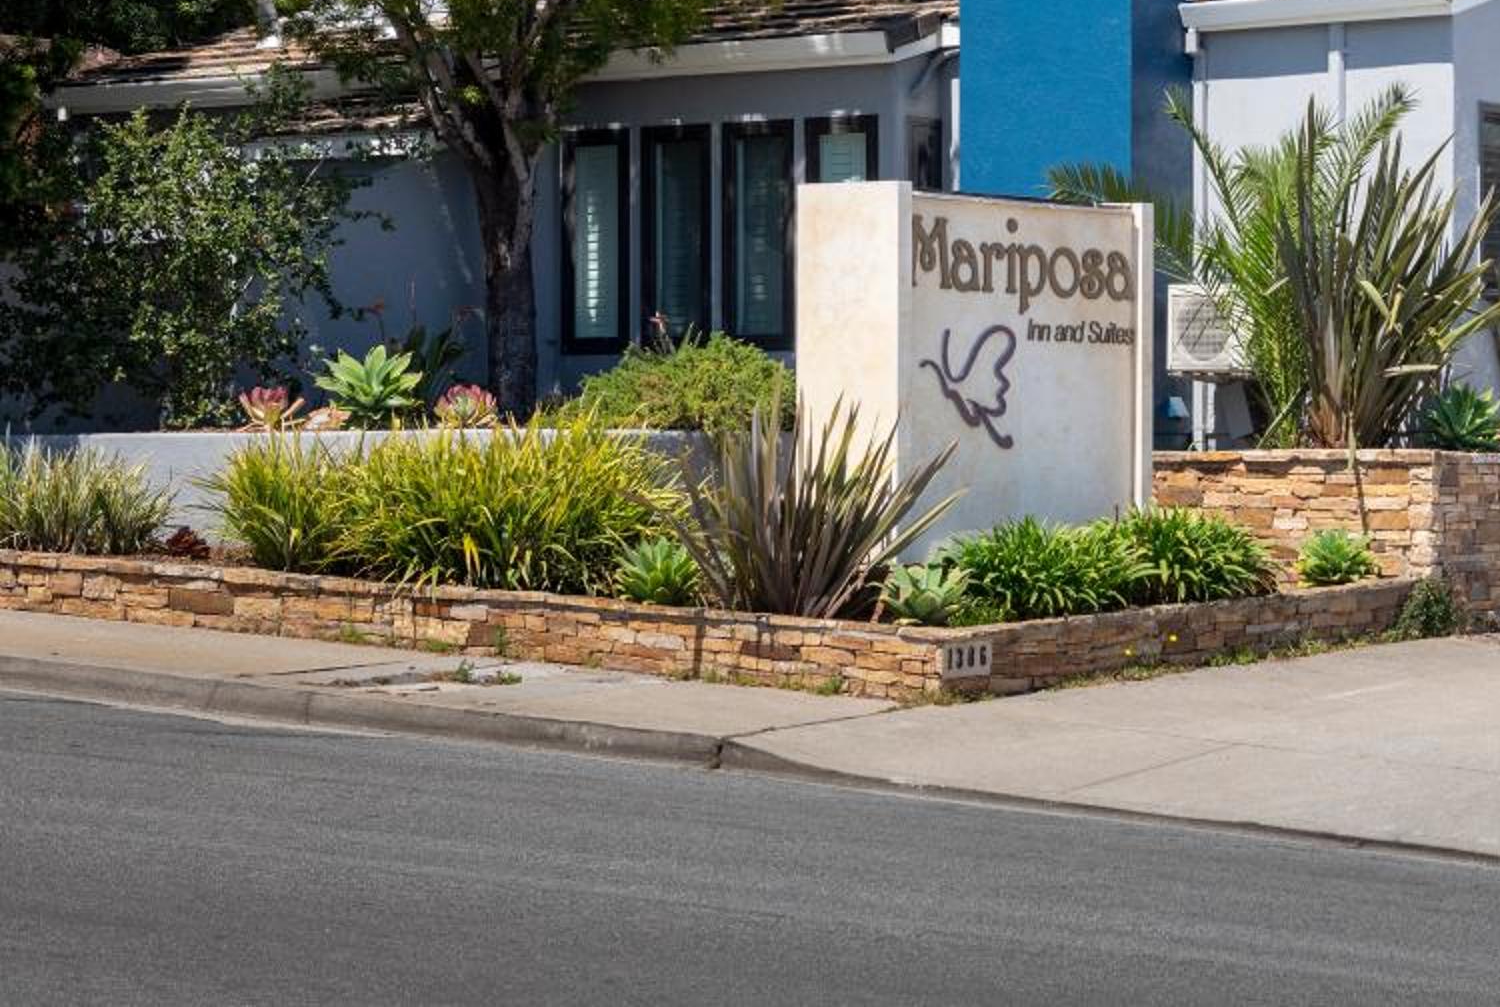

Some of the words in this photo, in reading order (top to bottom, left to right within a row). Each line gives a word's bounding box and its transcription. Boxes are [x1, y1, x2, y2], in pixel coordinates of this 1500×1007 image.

[912, 214, 1135, 315] Mariposa
[1027, 318, 1051, 342] Inn
[1054, 320, 1085, 344] and
[1087, 321, 1135, 346] Suites
